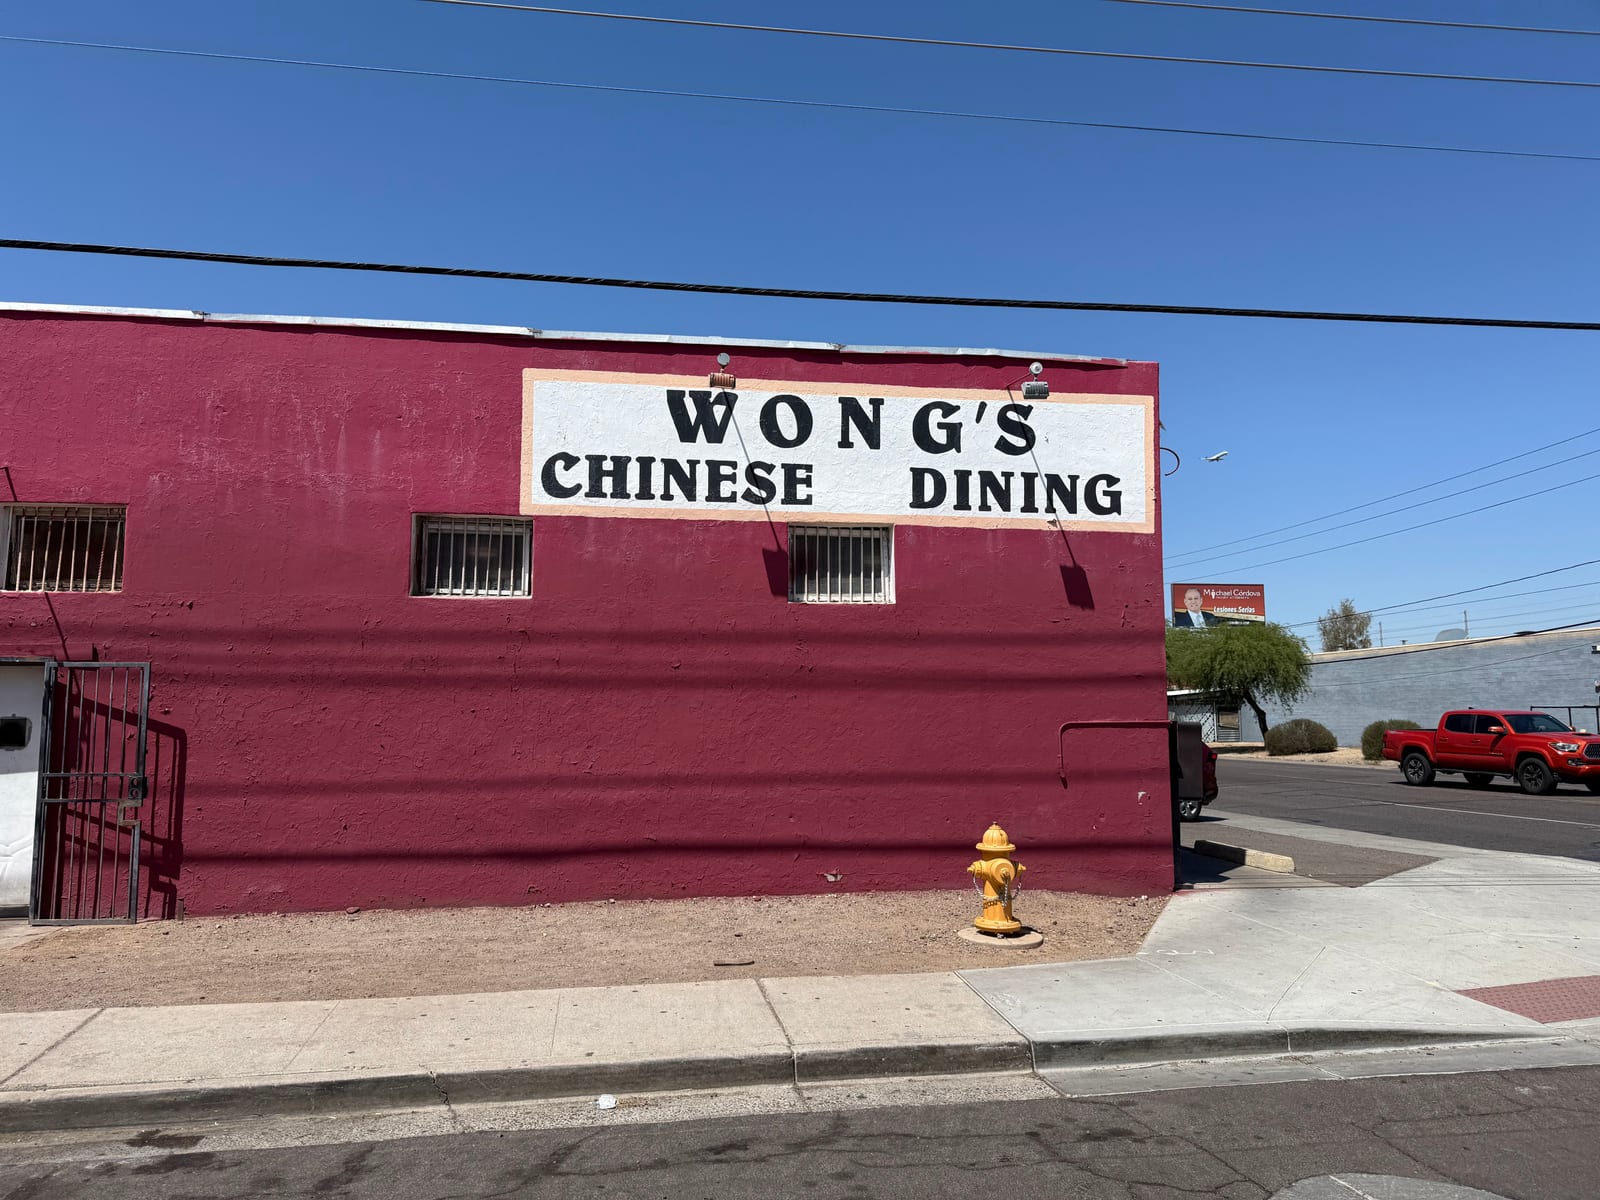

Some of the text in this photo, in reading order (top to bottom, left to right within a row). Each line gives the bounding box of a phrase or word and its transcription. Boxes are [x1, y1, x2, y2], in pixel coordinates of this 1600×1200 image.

[667, 389, 1036, 456] WONG'S
[541, 451, 1122, 516] CHINESE DINING
[1203, 588, 1232, 599] Michael
